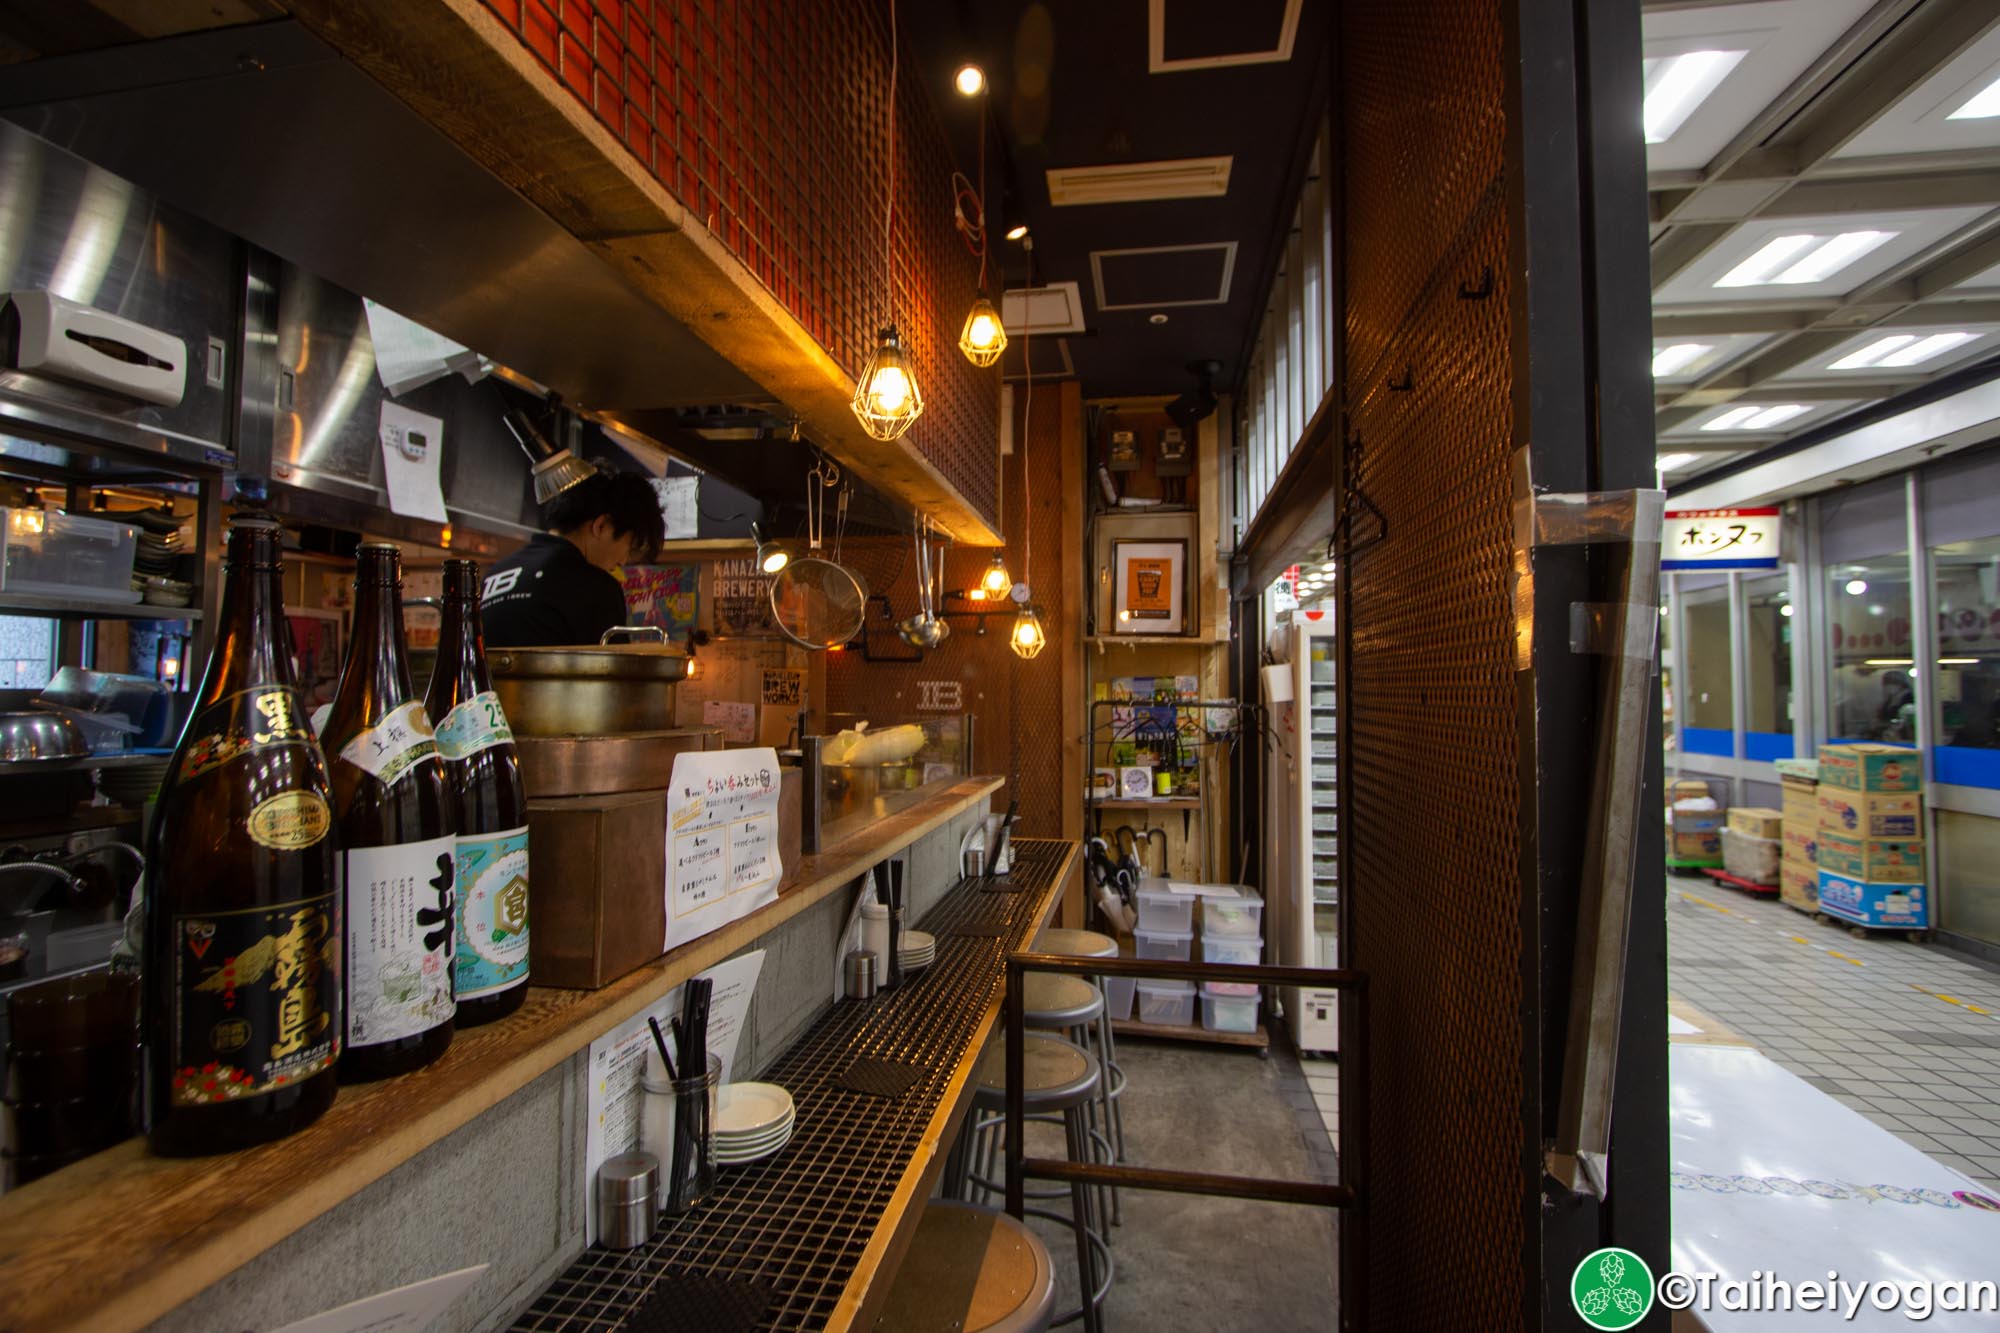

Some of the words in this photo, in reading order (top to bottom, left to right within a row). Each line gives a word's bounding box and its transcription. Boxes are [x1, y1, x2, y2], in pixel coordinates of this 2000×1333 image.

[713, 579, 773, 597] BREWERY
[763, 680, 800, 693] BREW
[763, 693, 800, 705] WORKS
